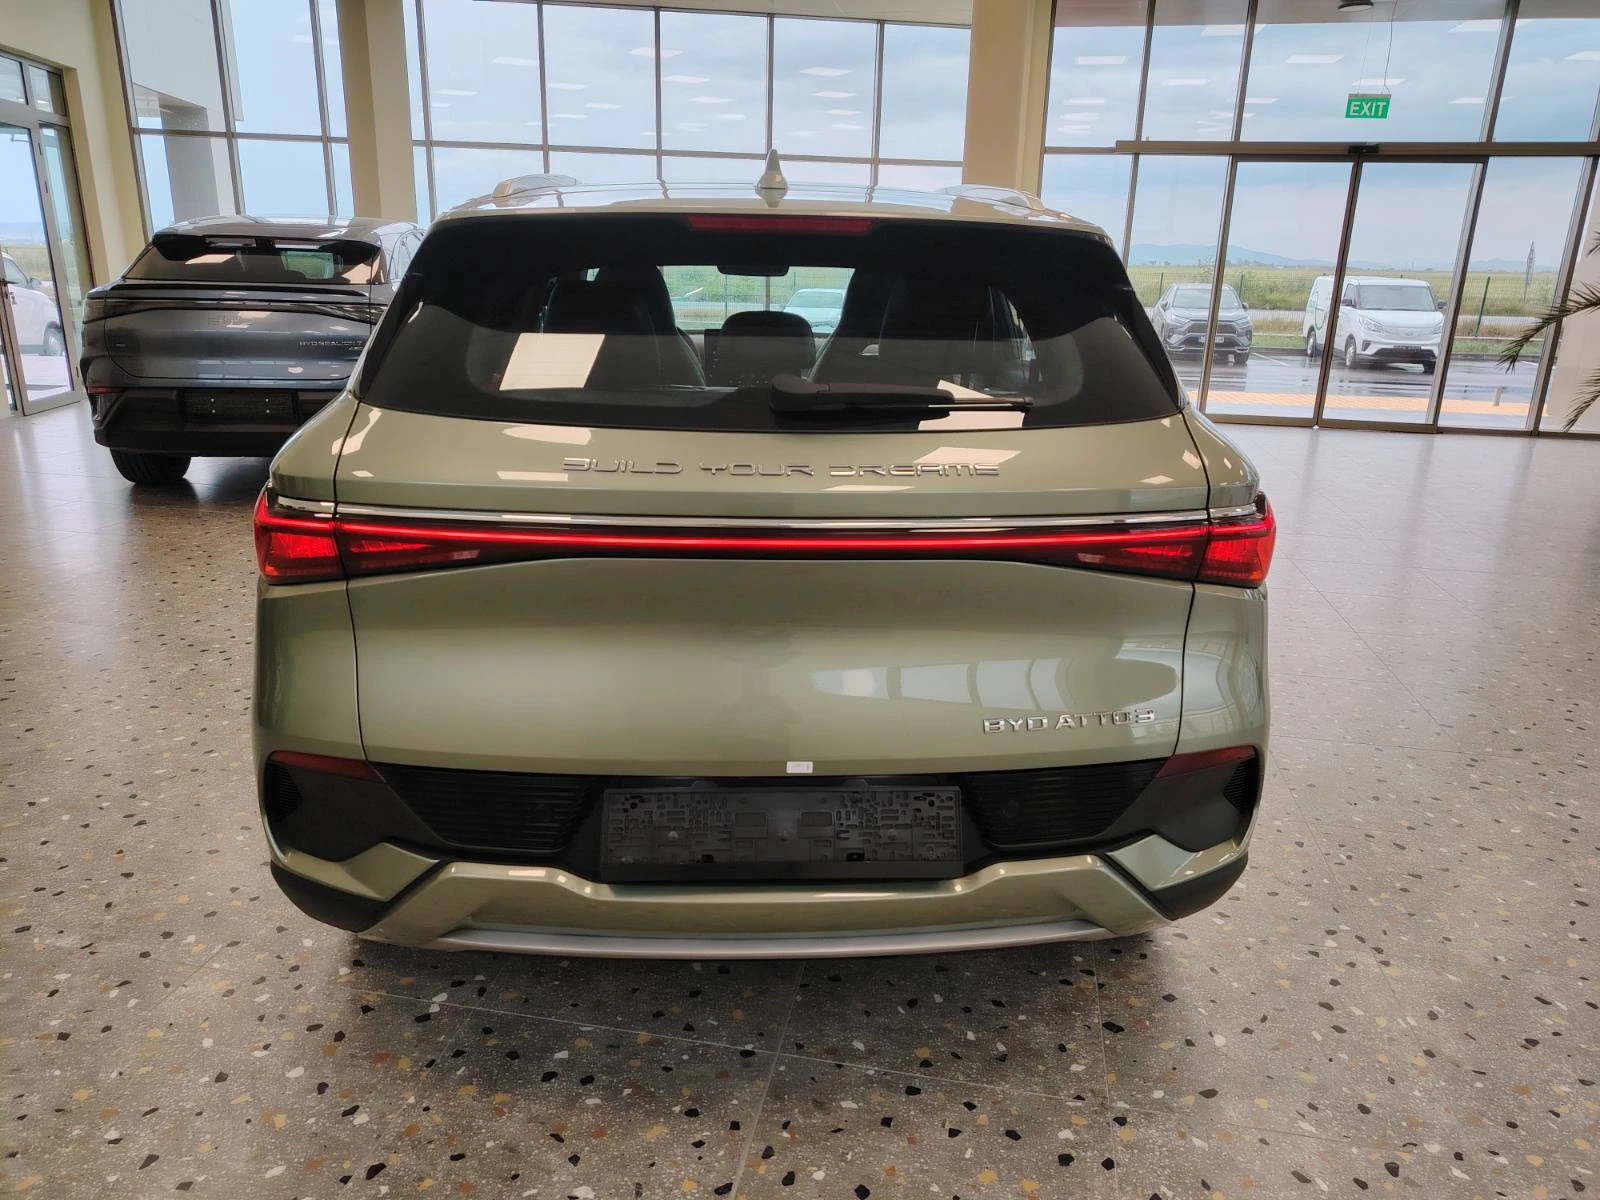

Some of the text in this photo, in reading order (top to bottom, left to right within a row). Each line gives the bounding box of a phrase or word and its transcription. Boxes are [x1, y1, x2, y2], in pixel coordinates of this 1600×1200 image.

[1350, 101, 1387, 116] EXIT
[563, 457, 1001, 477] BUILD YOUR DREAMS
[983, 716, 1048, 734] BYD
